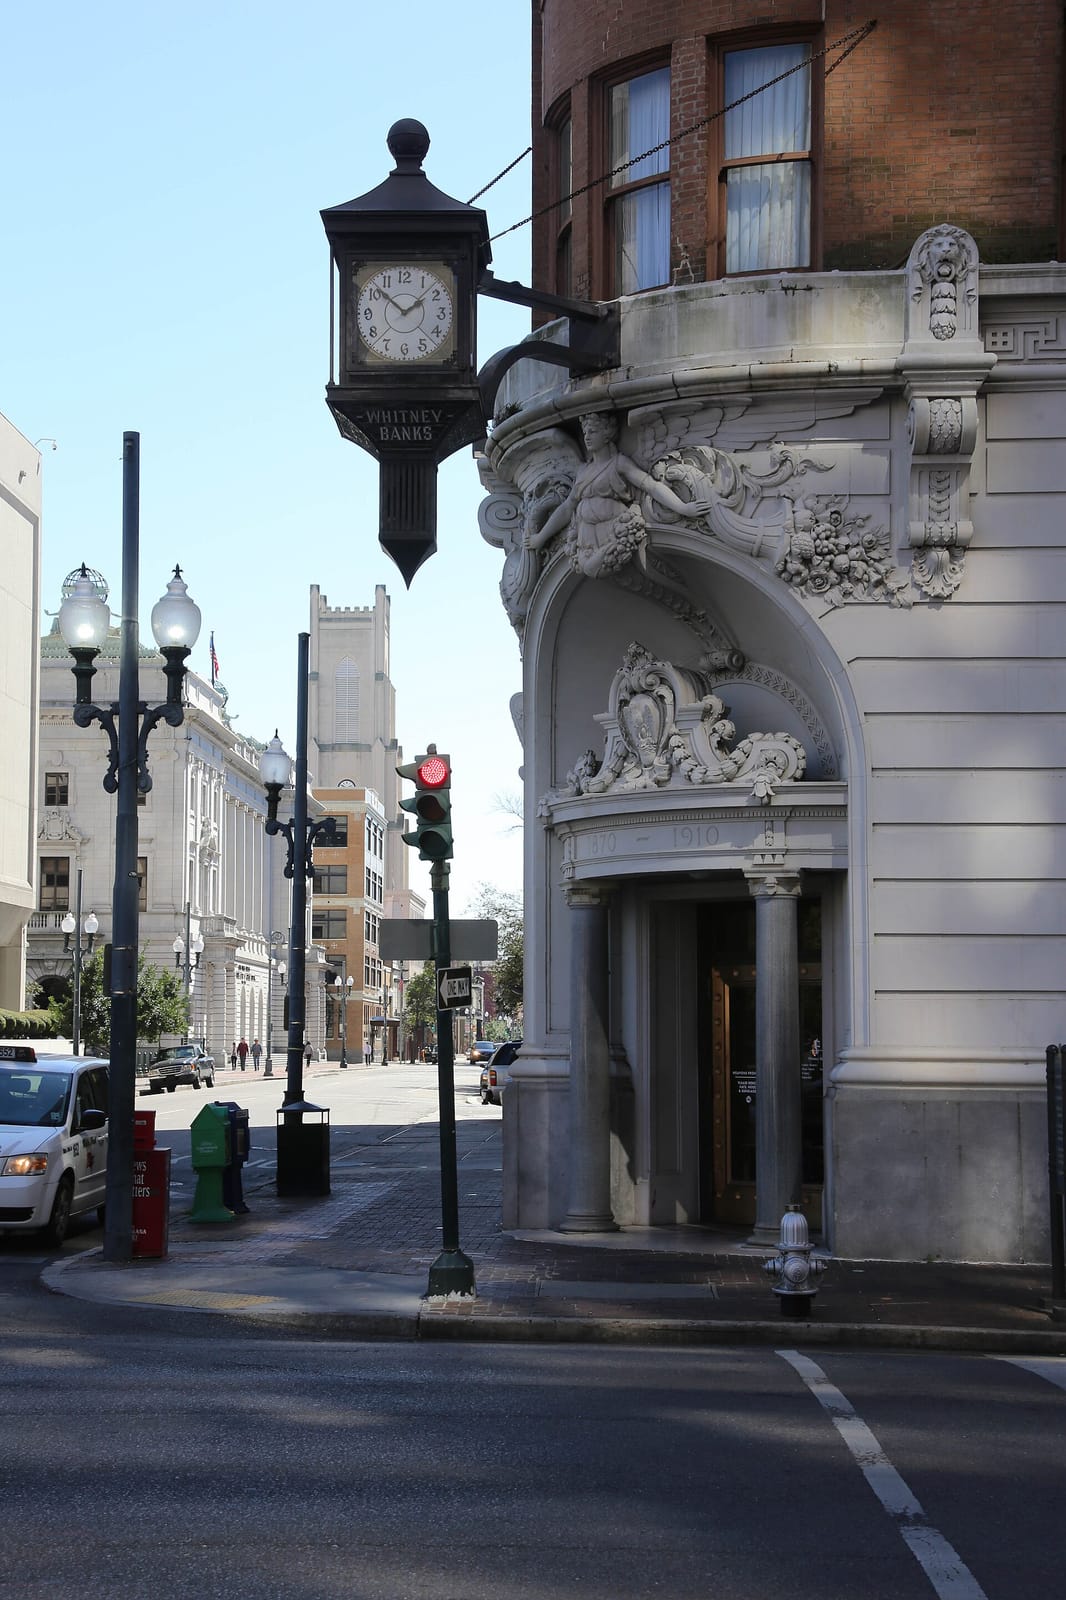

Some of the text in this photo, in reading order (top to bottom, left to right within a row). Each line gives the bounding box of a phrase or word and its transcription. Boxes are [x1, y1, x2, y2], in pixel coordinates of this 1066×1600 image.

[383, 275, 391, 288] 11
[398, 270, 412, 284] 12
[421, 275, 425, 288] 1
[369, 287, 382, 301] 10
[431, 288, 441, 301] 2
[363, 307, 373, 321] 9
[436, 307, 446, 320] 3
[369, 325, 378, 338] 8
[431, 324, 442, 338] 4
[382, 338, 391, 352] 7
[400, 342, 409, 355] 6
[417, 338, 428, 352] 5
[366, 410, 442, 424] WHITNEY
[380, 425, 433, 441] BANKS
[590, 832, 617, 854] 870
[673, 825, 719, 847] 1910
[447, 979, 470, 996] ONE WAY
